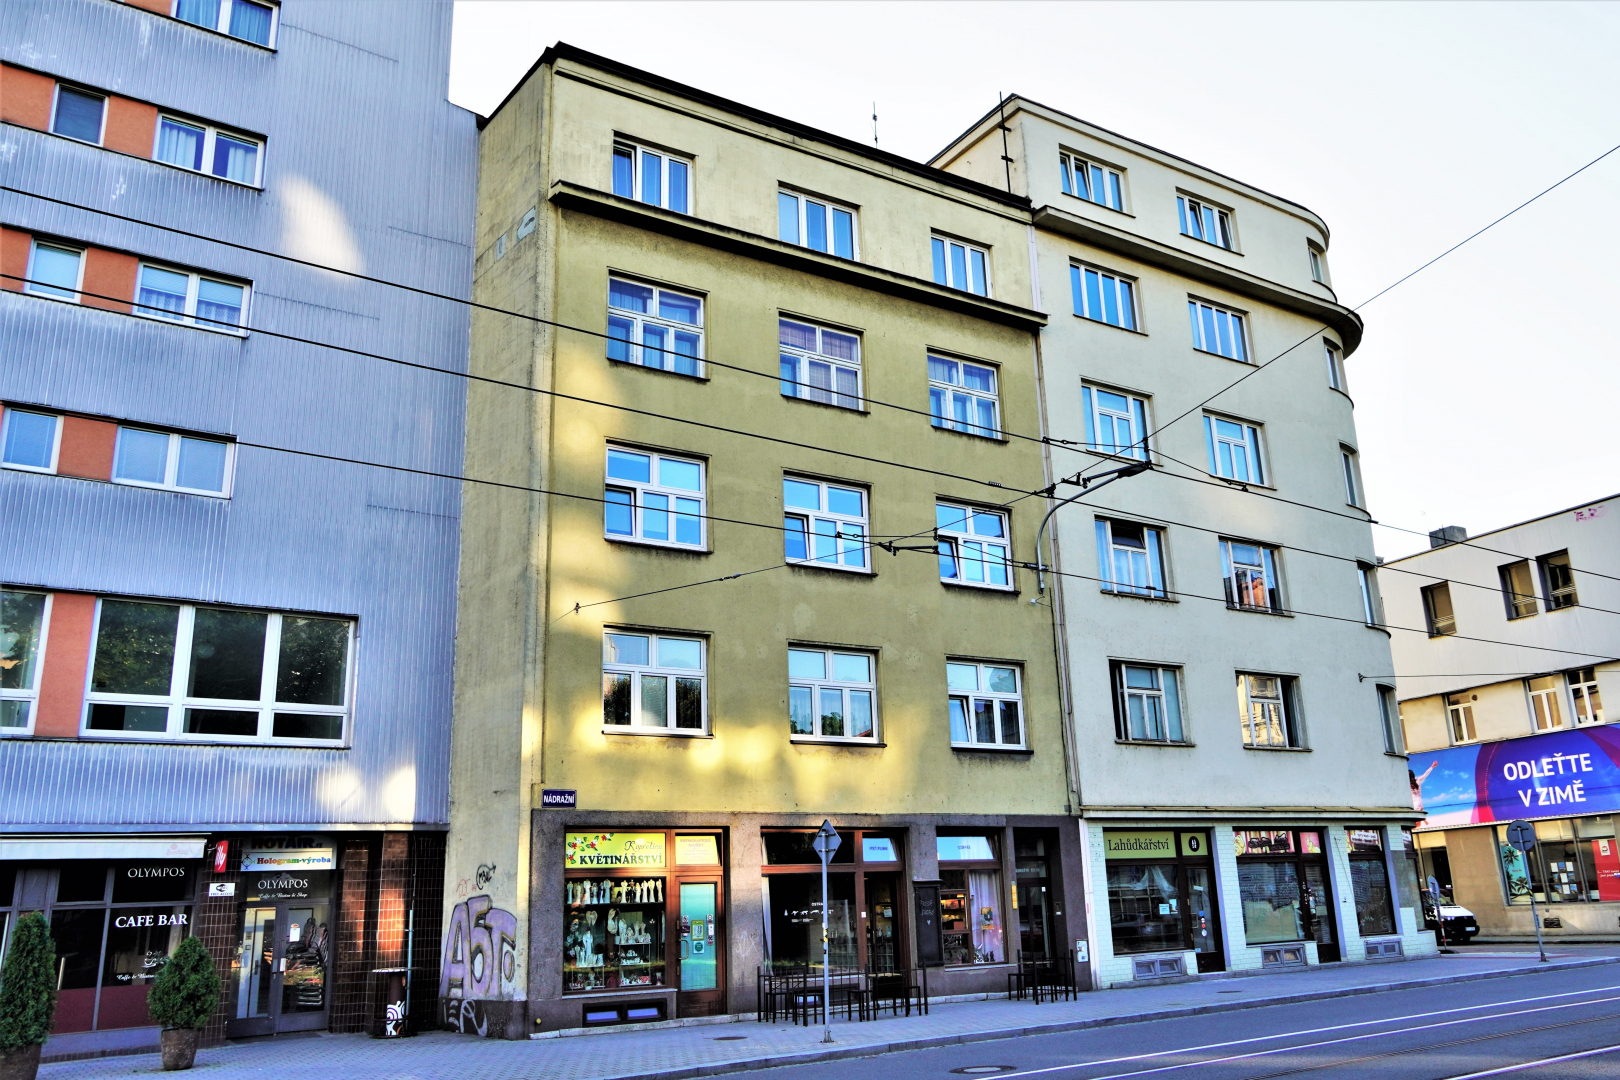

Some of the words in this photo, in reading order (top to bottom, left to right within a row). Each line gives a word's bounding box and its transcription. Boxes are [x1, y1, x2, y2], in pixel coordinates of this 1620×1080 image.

[1503, 752, 1593, 781] ODLEŤTE
[543, 794, 575, 804] NÁDRAŽNÍ
[1517, 789, 1532, 807] V
[1535, 779, 1586, 806] ZIMĚ
[1108, 838, 1169, 851] Lahůdkářství
[579, 852, 663, 865] KVĚTINÁŘSTVÍ
[127, 867, 185, 878] OLYMPOS
[258, 879, 308, 889] OLYMPOS
[115, 915, 154, 928] CAFE
[157, 914, 188, 926] BAR
